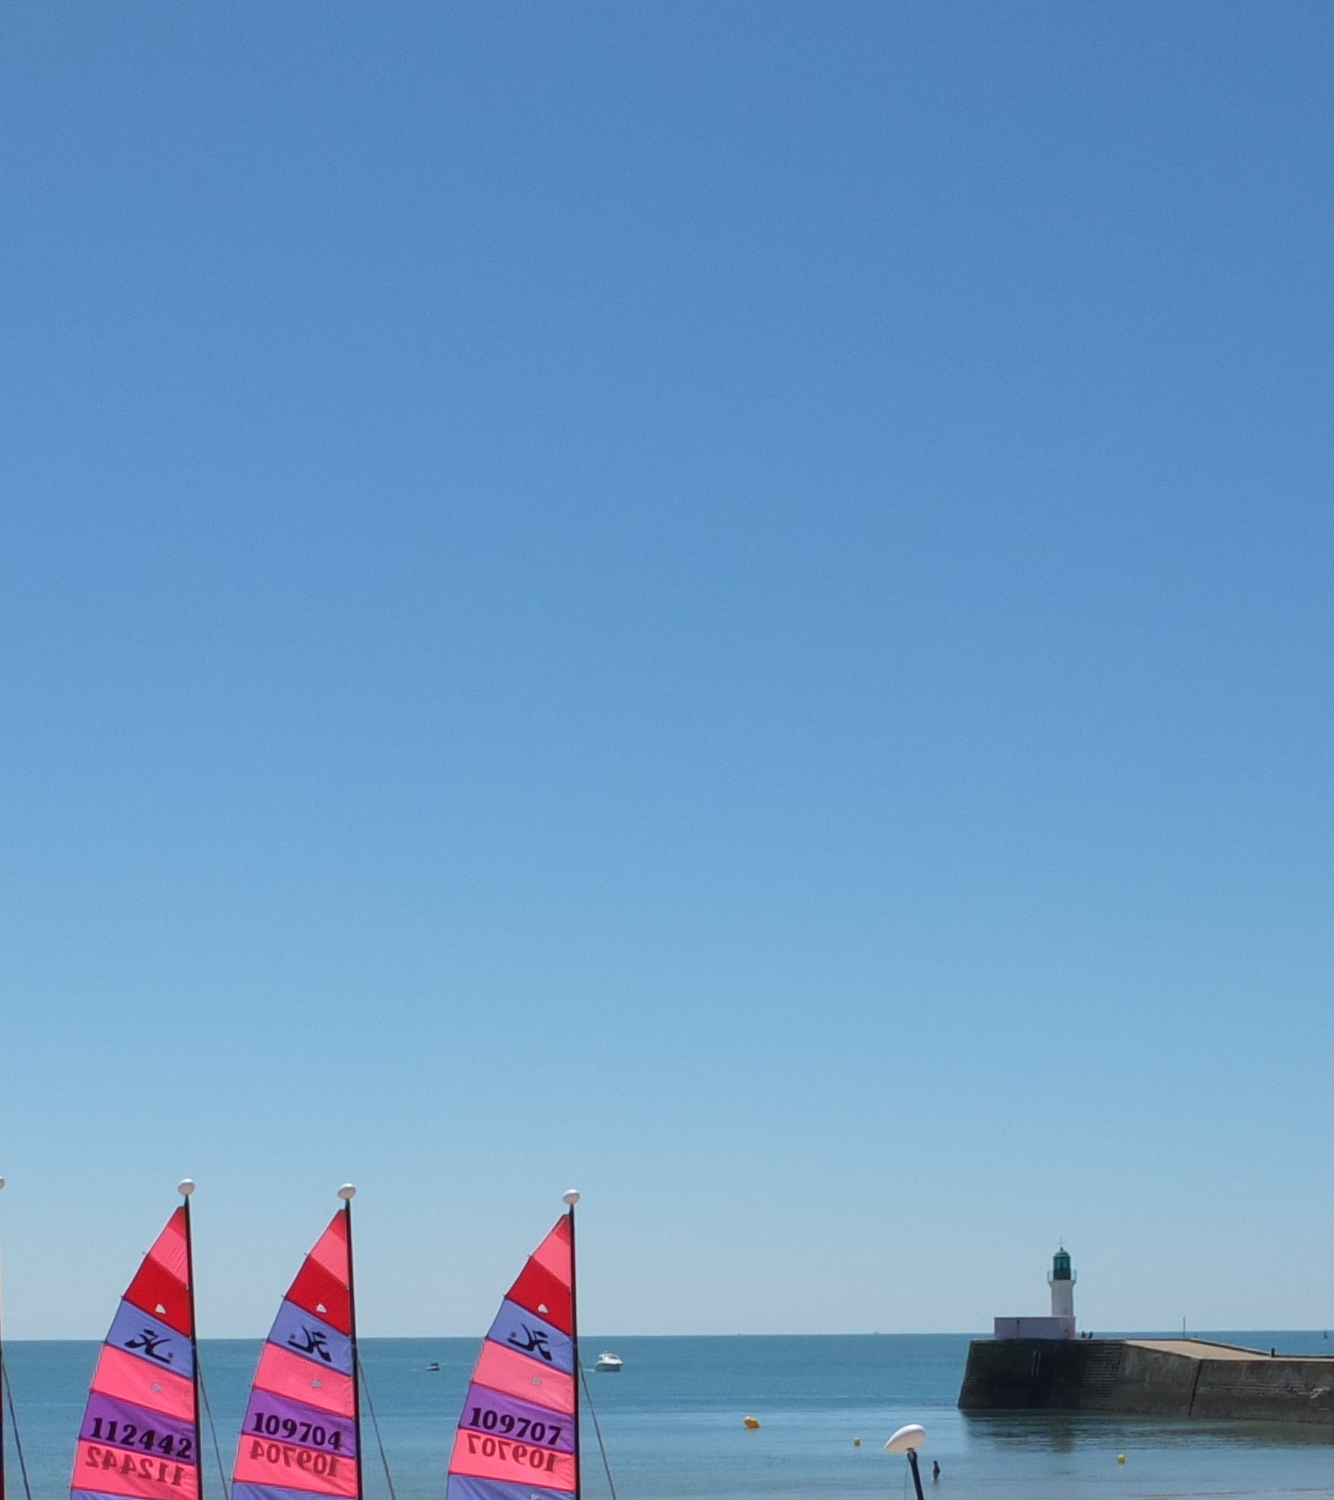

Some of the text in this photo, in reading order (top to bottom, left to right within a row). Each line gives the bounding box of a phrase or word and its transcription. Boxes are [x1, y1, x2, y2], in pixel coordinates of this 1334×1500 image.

[89, 1417, 193, 1459] 112442
[251, 1412, 342, 1451] 109704
[469, 1407, 563, 1445] 109707
